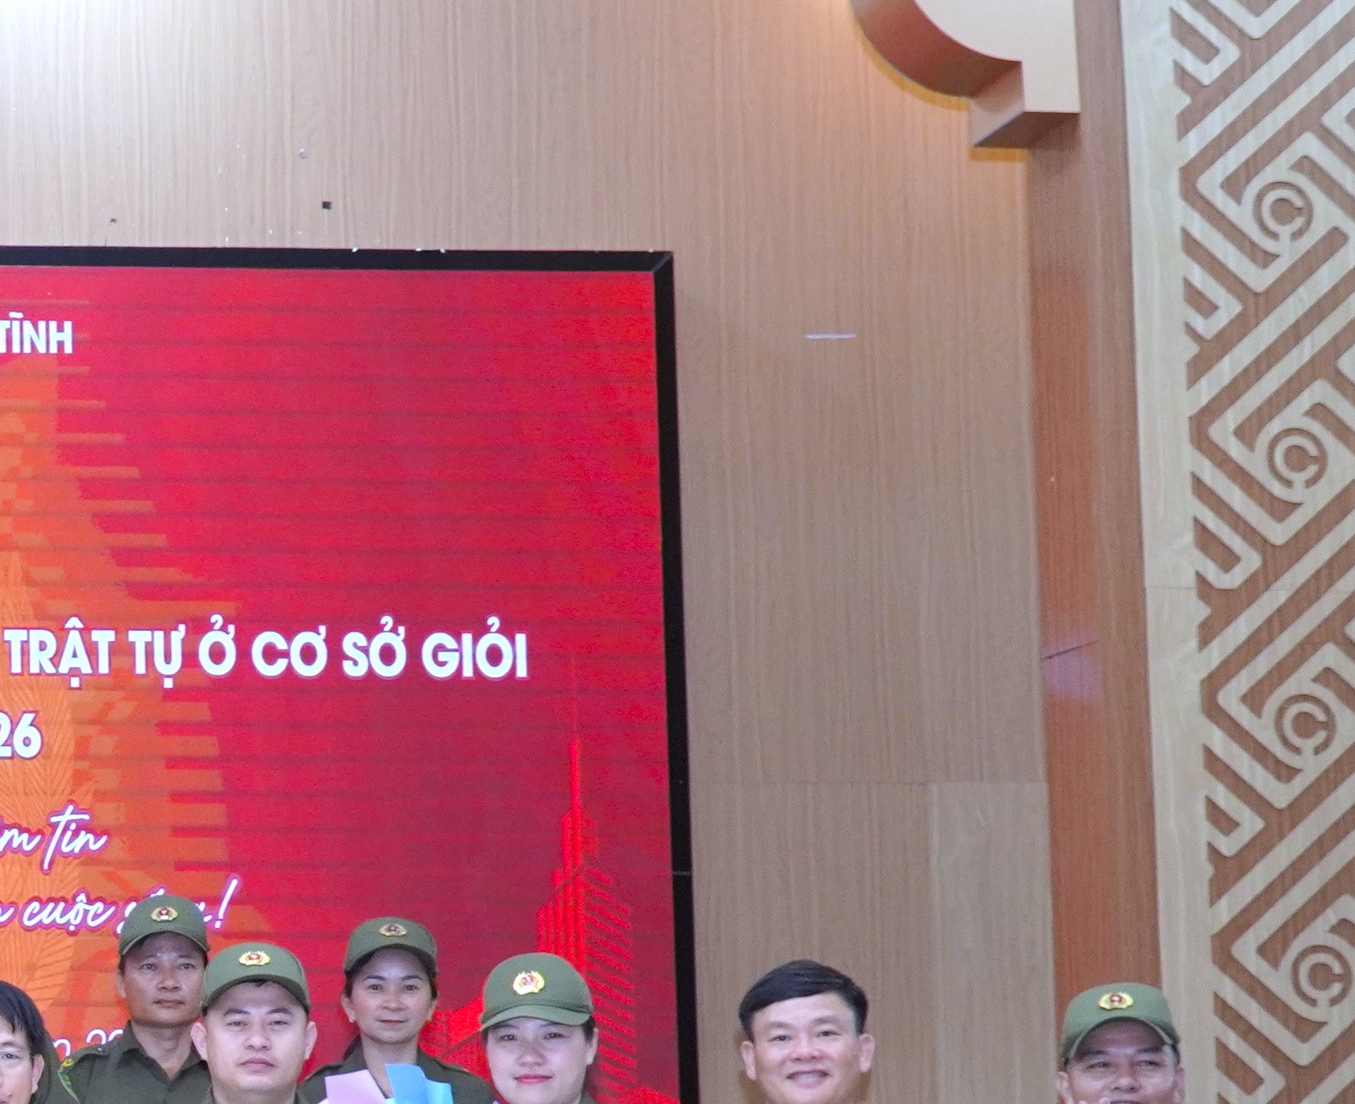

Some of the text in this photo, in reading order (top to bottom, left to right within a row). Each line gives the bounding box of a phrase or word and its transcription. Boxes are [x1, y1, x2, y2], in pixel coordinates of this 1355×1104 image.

[3, 617, 116, 688] TRẬT
[128, 624, 186, 689] TỰ
[198, 614, 237, 676] Ở
[251, 625, 328, 677] CƠ
[342, 615, 407, 678] SỞ
[422, 616, 528, 680] GIỎI
[21, 898, 115, 932] cuộc
